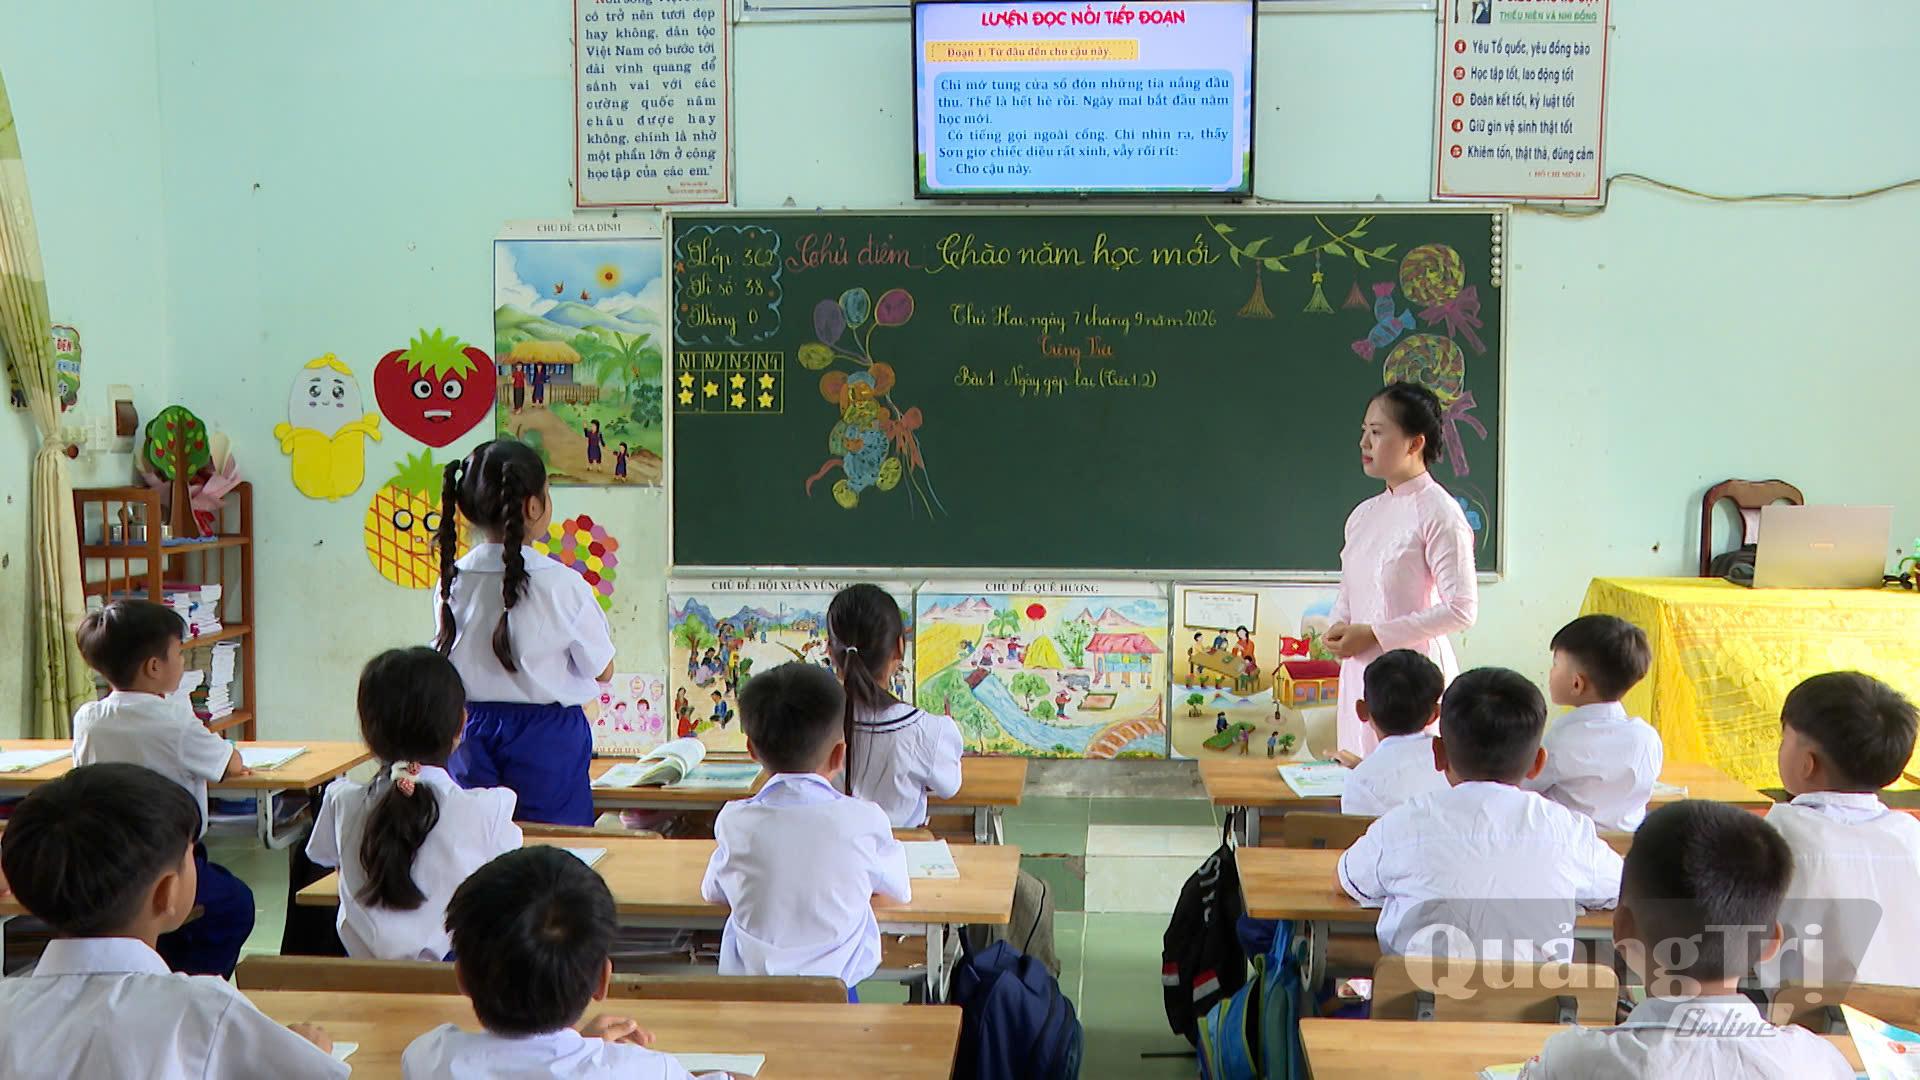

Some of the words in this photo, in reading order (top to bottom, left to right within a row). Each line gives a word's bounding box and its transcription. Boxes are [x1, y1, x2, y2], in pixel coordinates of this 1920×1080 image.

[585, 11, 598, 22] có
[632, 9, 653, 21] nên
[662, 9, 685, 20] tươi
[693, 7, 714, 22] đẹp
[982, 9, 1028, 27] LUYỆN
[1032, 11, 1067, 28] ĐỌC
[1072, 6, 1100, 25] NỐI
[1105, 4, 1135, 25] TIẾP
[1139, 9, 1186, 28] ĐOẠN
[586, 29, 608, 42] hay
[666, 26, 688, 37] dân
[586, 46, 611, 59] Việt
[616, 45, 644, 56] Nam
[648, 44, 661, 55] có
[666, 43, 694, 54] bước
[699, 43, 716, 57] tới
[1472, 40, 1488, 54] Yêu
[616, 63, 642, 74] vinh
[653, 63, 692, 75] quang
[1522, 67, 1535, 80] lao
[586, 80, 616, 91] sánh
[630, 80, 649, 90] vai
[662, 79, 682, 90] với
[695, 78, 716, 89] các
[942, 80, 960, 90] Chi
[992, 80, 1020, 92] tung
[1148, 78, 1164, 88] tia
[938, 97, 962, 107] thu.
[997, 96, 1006, 107] là
[1119, 96, 1142, 106] mai
[688, 113, 716, 126] hay
[939, 114, 960, 126] học
[1518, 119, 1537, 133] sinh
[948, 130, 962, 140] Có
[1008, 130, 1026, 143] gọi
[1115, 129, 1134, 139] Chi
[651, 149, 670, 160] lớn
[686, 148, 716, 161] công
[939, 148, 962, 157] Sơn
[636, 164, 657, 178] của
[664, 166, 683, 177] các
[956, 164, 979, 174] Cho
[925, 233, 1010, 274] Chào
[1017, 241, 1085, 265] năm
[1093, 233, 1143, 271] học
[1150, 233, 1220, 265] mới
[745, 278, 764, 296] 38
[1135, 311, 1143, 326] 9
[1184, 309, 1216, 327] 2026
[679, 353, 696, 369] N1
[729, 353, 751, 369] N3
